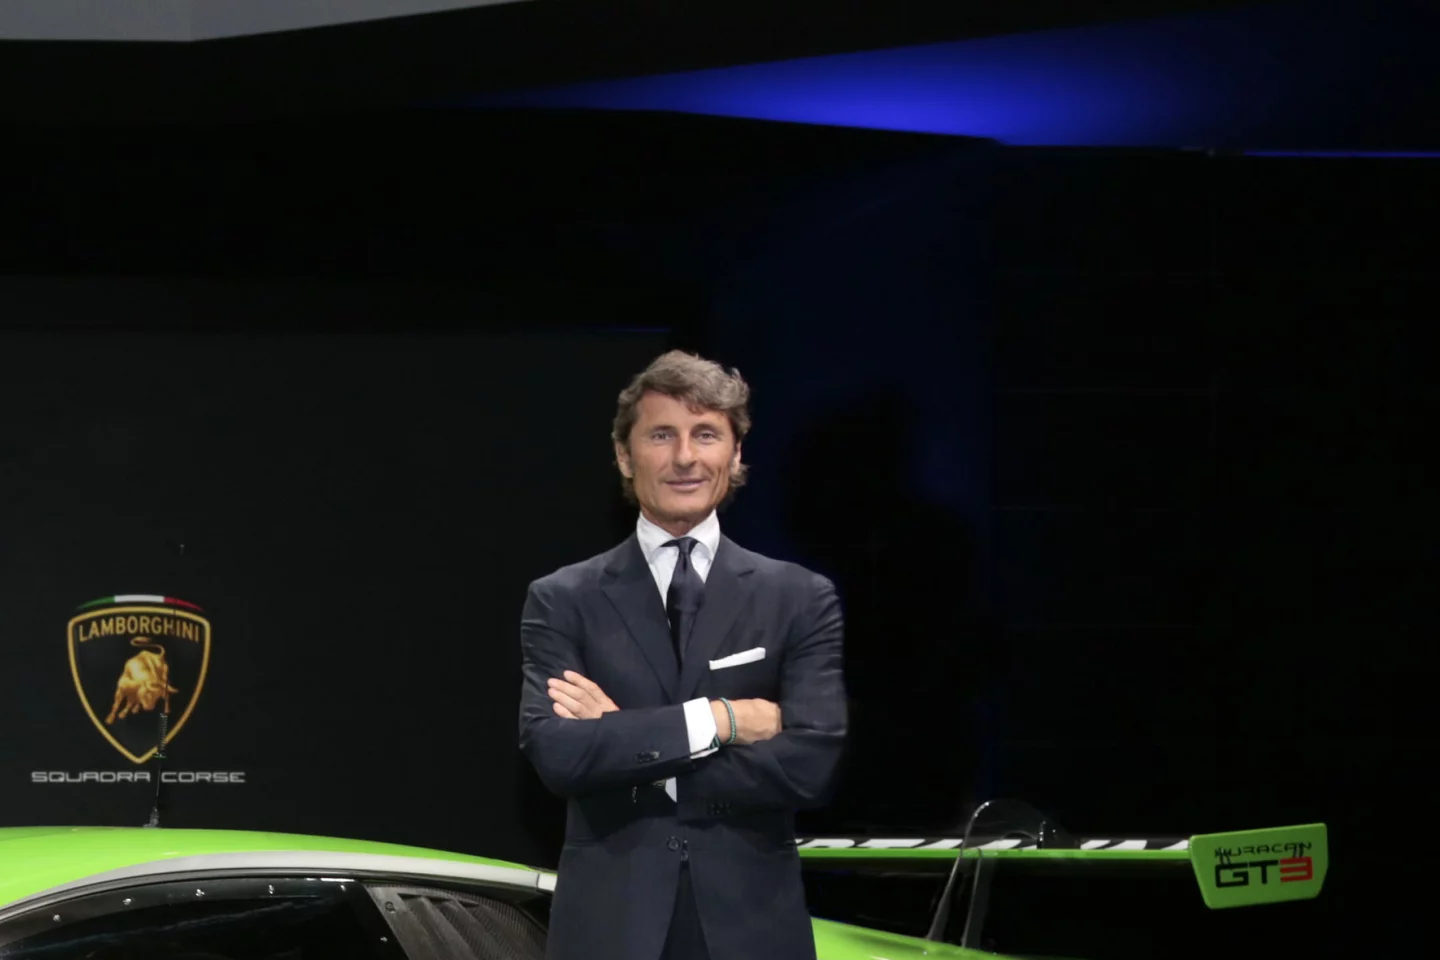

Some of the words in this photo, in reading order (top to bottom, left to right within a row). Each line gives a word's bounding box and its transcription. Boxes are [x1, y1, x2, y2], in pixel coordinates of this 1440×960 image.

[78, 615, 201, 644] LAMBORGHINI
[31, 771, 151, 783] SQUADRA
[161, 771, 246, 783] CORSE
[1215, 856, 1313, 888] GT3
